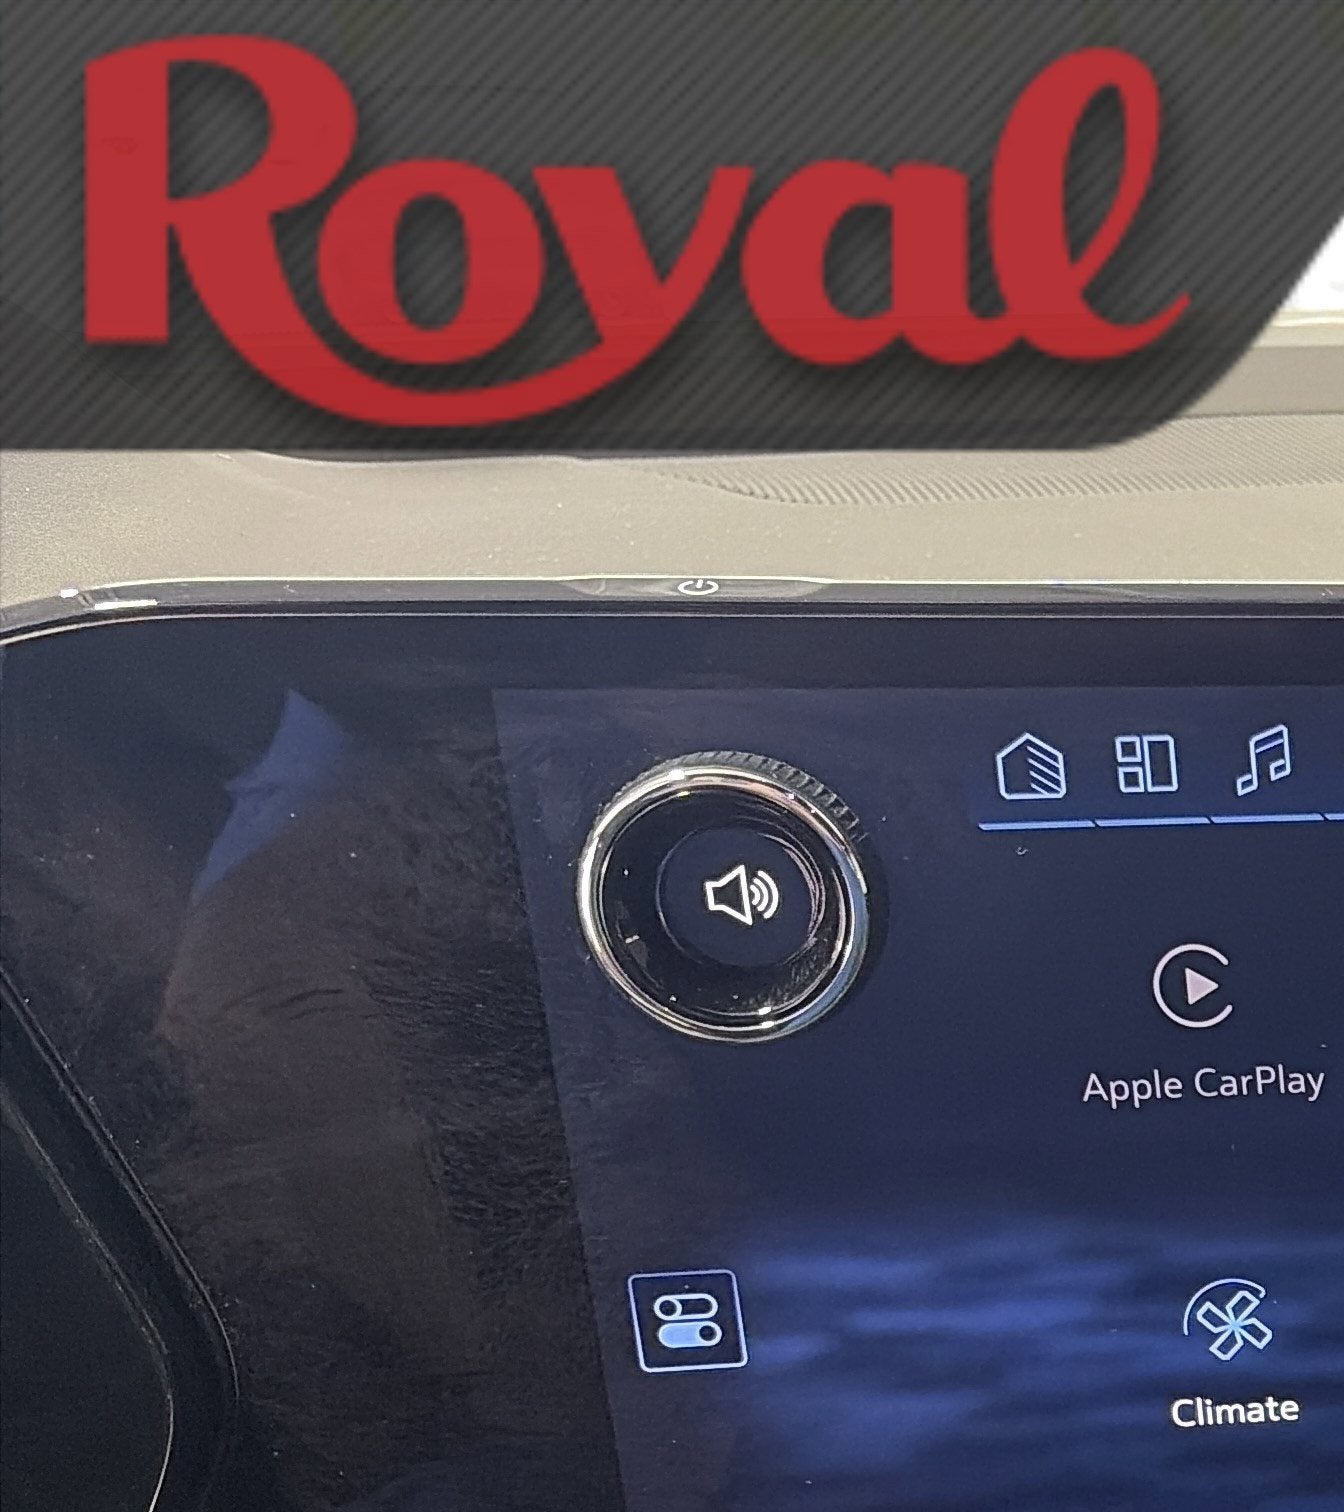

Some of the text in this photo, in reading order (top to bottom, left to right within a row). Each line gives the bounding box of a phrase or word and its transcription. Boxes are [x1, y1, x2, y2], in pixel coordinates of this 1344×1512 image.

[1083, 1064, 1324, 1109] Apple CarPlay
[1172, 1397, 1299, 1427] Climate
